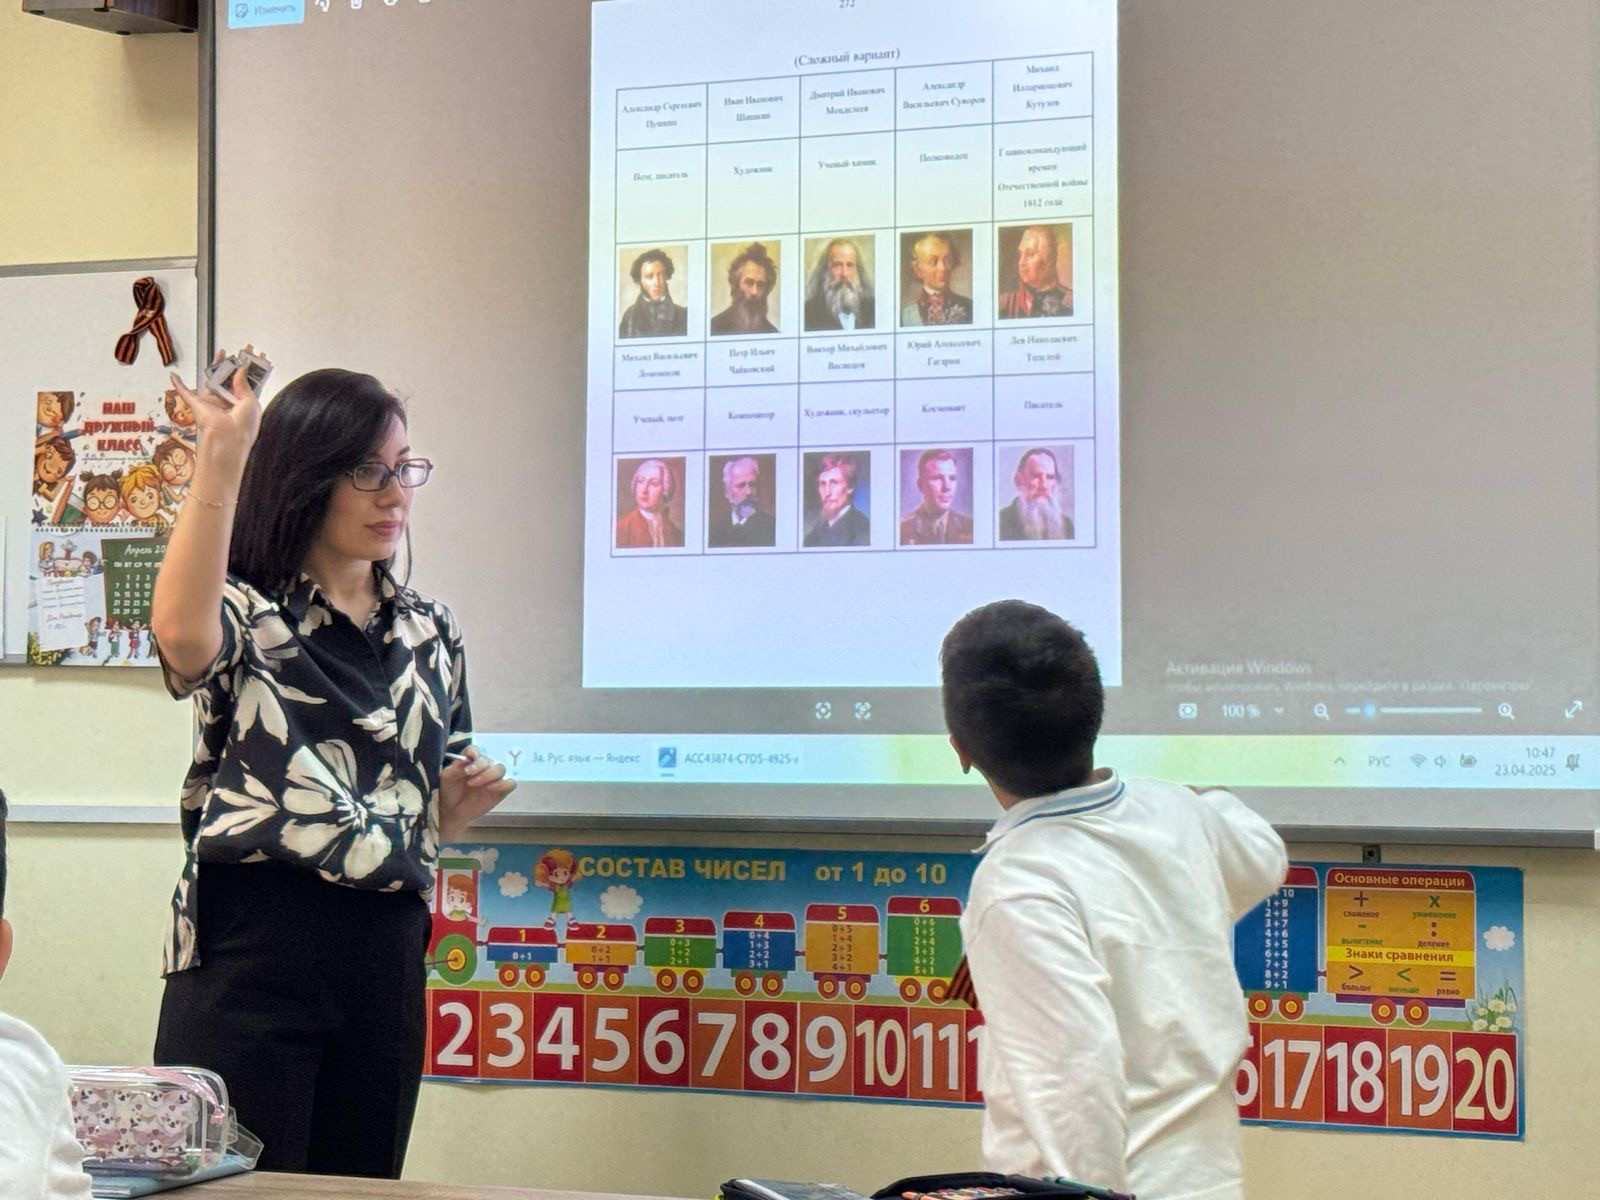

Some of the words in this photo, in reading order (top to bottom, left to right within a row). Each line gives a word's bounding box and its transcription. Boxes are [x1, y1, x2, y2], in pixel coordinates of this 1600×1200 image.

[793, 51, 850, 69] (Сложный
[853, 48, 901, 64] вариант)
[102, 402, 136, 415] НАШ
[83, 418, 155, 436] ДРУЖНЫЙ
[97, 438, 142, 452] КЛАСС
[124, 544, 153, 557] Апрель
[1221, 704, 1245, 717] 100
[1525, 746, 1556, 759] 10:47
[1368, 755, 1391, 767] РУС
[1494, 763, 1557, 777] 23.04.2025
[578, 856, 686, 879] СОСТАВ
[694, 859, 787, 882] ЧИСЕЛ
[815, 865, 843, 882] от
[852, 862, 864, 882] 1
[874, 867, 907, 887] до
[915, 863, 947, 885] 10
[1334, 872, 1400, 887] Основные
[1402, 875, 1466, 889] операции
[919, 899, 930, 913] 6
[837, 906, 847, 921] 5
[675, 919, 685, 933] 3
[754, 914, 765, 928] 4
[518, 928, 527, 943] 1
[596, 925, 606, 939] 2
[1345, 947, 1383, 960] Знаки
[1386, 950, 1454, 963] сравнения
[436, 1003, 474, 1067] 2
[487, 1003, 526, 1069] 3
[537, 1006, 580, 1071] 4
[592, 1007, 630, 1073] 5
[643, 1010, 685, 1075] 6
[697, 1012, 737, 1077] 7
[750, 1012, 791, 1080] 8
[805, 1015, 848, 1082] 9
[855, 1018, 907, 1087] 10
[913, 1022, 959, 1091] 11
[1263, 1039, 1321, 1110] 17
[1326, 1041, 1384, 1113] 18
[1390, 1044, 1449, 1117] 19
[1454, 1047, 1514, 1121] 20
